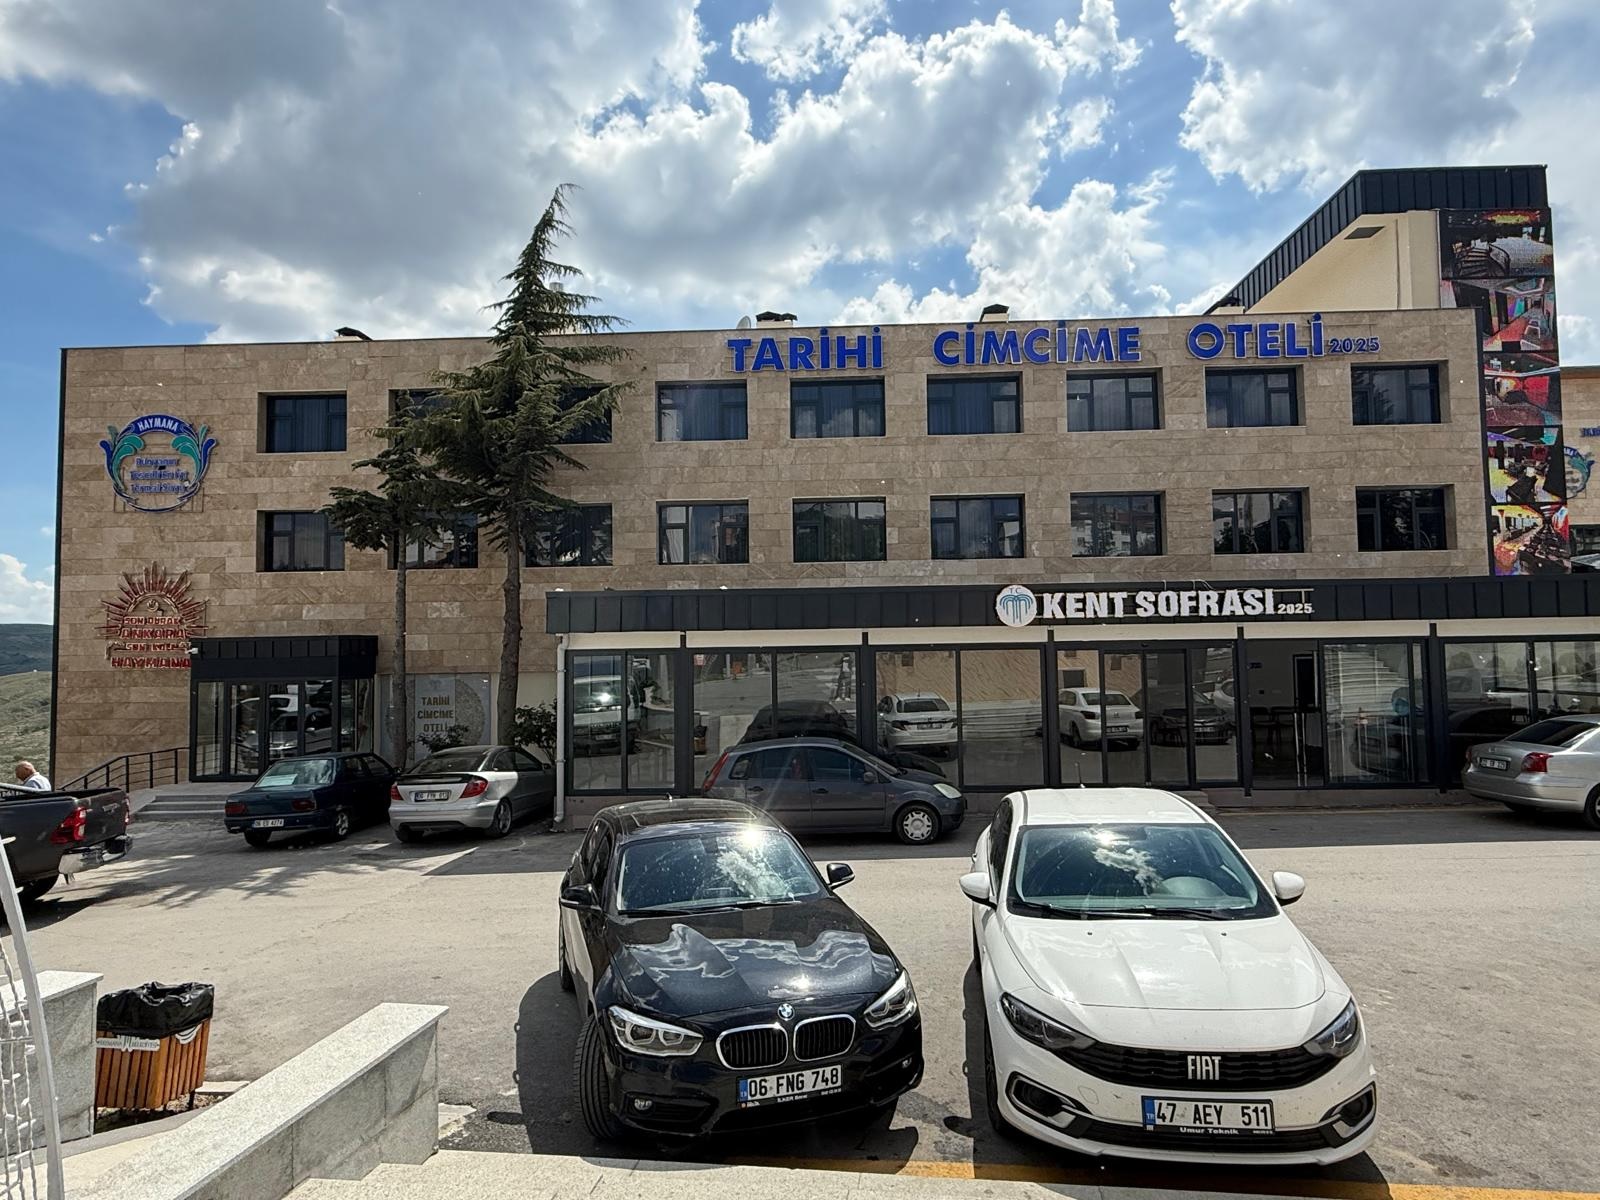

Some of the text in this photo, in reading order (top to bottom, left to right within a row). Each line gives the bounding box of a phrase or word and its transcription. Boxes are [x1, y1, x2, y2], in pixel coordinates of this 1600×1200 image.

[727, 313, 1380, 373] TARİHİ CİMCİME OTELİ 2025
[138, 418, 178, 431] HAYMANA
[1043, 588, 1313, 619] KENT SOFRASI 2025
[123, 616, 145, 625] SON
[121, 628, 186, 639] ANKARA
[111, 657, 191, 668] HAYMANA
[421, 695, 450, 706] TARİHİ
[1187, 1055, 1222, 1081] FIAT
[749, 1068, 839, 1097] 06 FNG 748
[1157, 1102, 1268, 1127] 47 AEY 511
